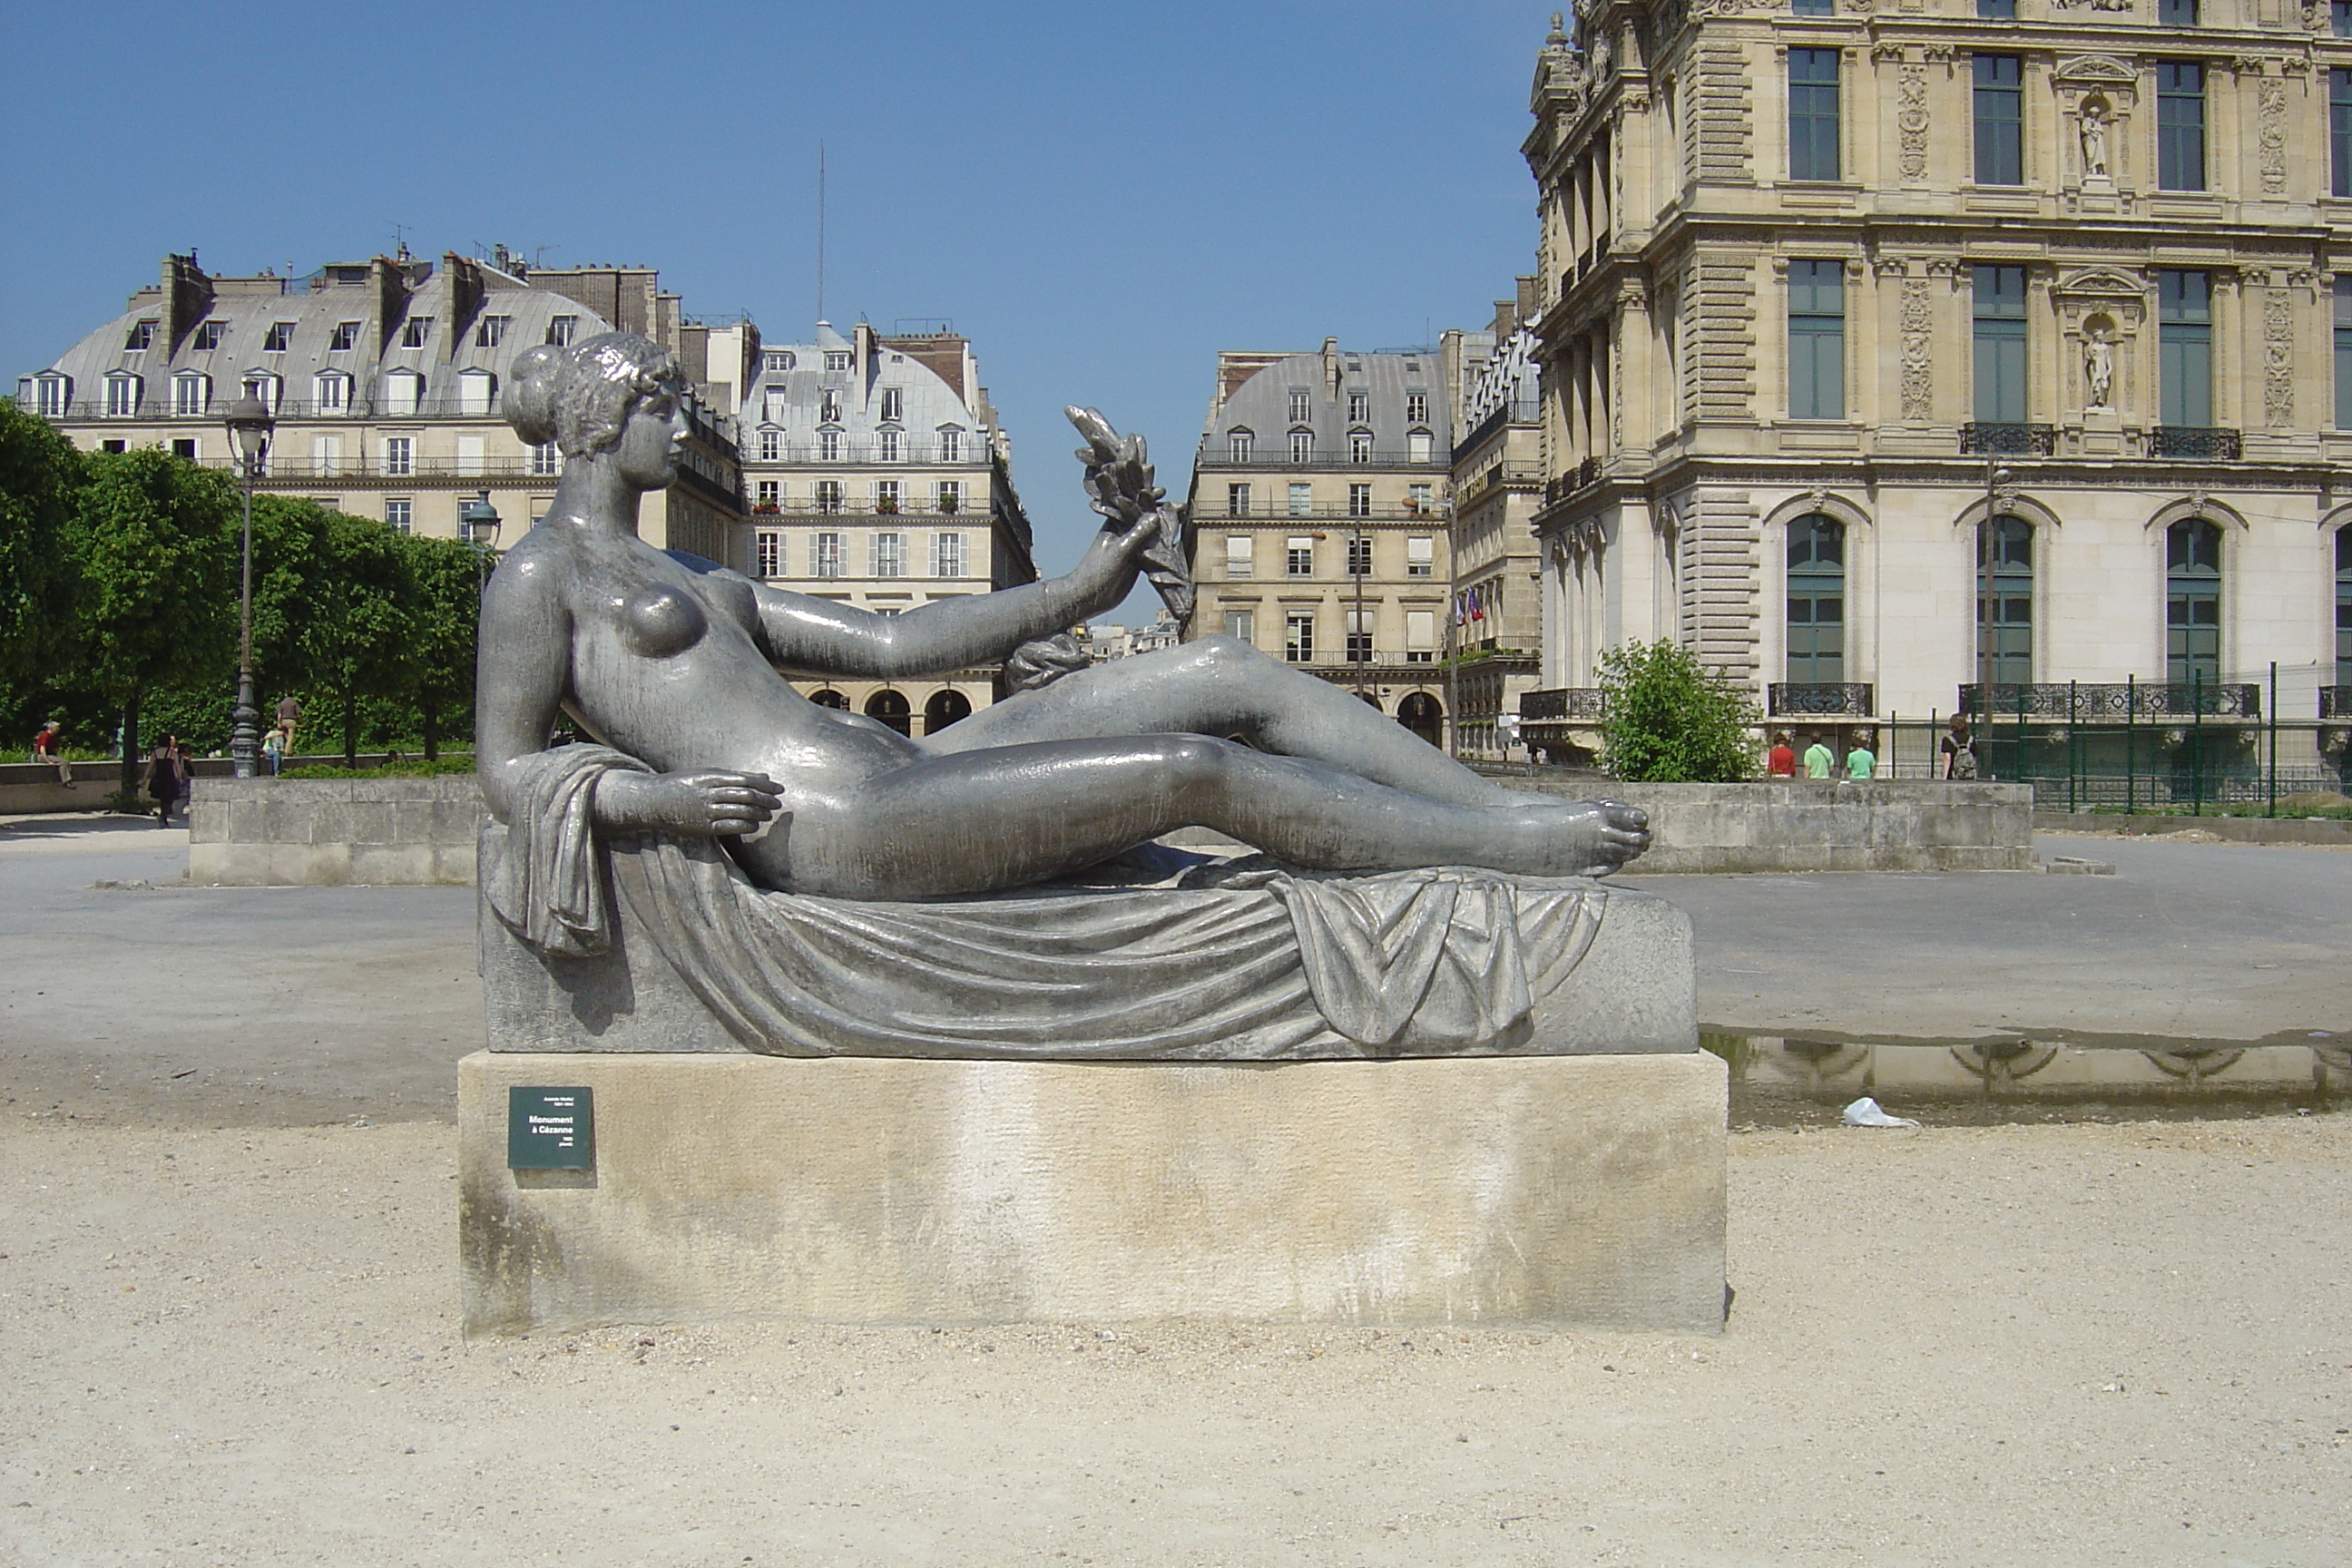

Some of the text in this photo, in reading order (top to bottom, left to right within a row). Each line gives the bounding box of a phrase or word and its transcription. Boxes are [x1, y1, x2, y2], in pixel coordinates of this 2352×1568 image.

[529, 1115, 573, 1124] Monument
[532, 1125, 573, 1134] à Cézanne
